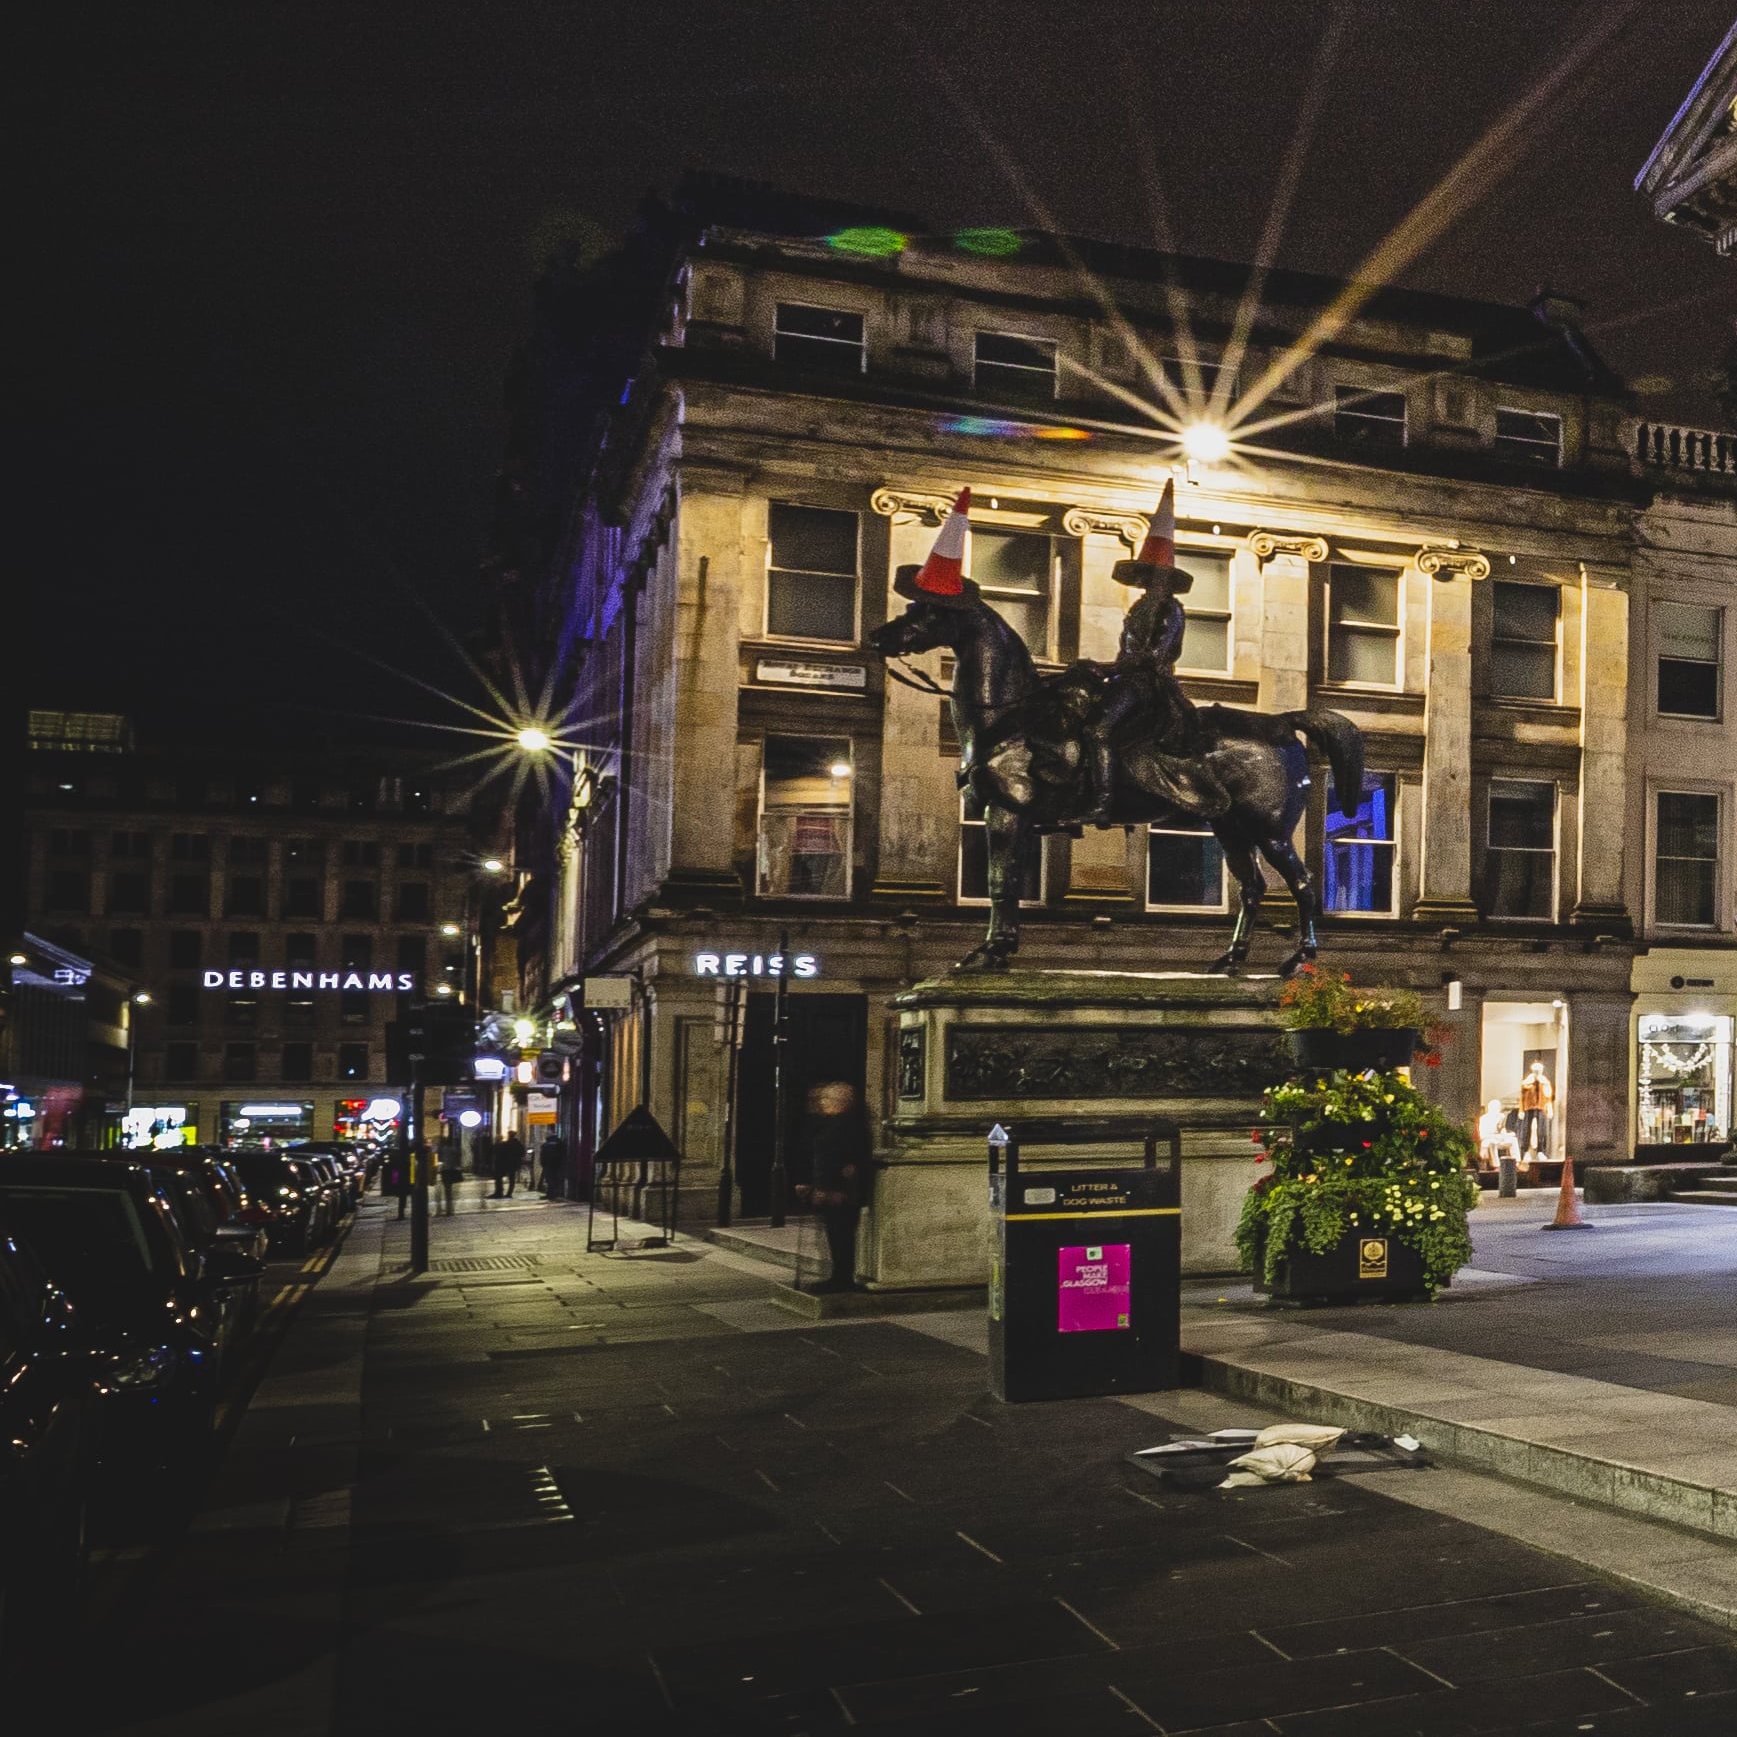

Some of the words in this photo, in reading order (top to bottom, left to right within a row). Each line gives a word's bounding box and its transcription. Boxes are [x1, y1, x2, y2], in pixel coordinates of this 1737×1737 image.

[696, 954, 818, 976] REISS
[203, 971, 413, 991] DEBENHAMS
[1071, 1183, 1109, 1192] LITTER
[1063, 1197, 1088, 1206] DOG
[1088, 1195, 1127, 1205] WASTE
[1075, 1264, 1108, 1274] PEOPLE
[1083, 1272, 1108, 1280] MAKE
[1062, 1278, 1108, 1288] GLASGOW
